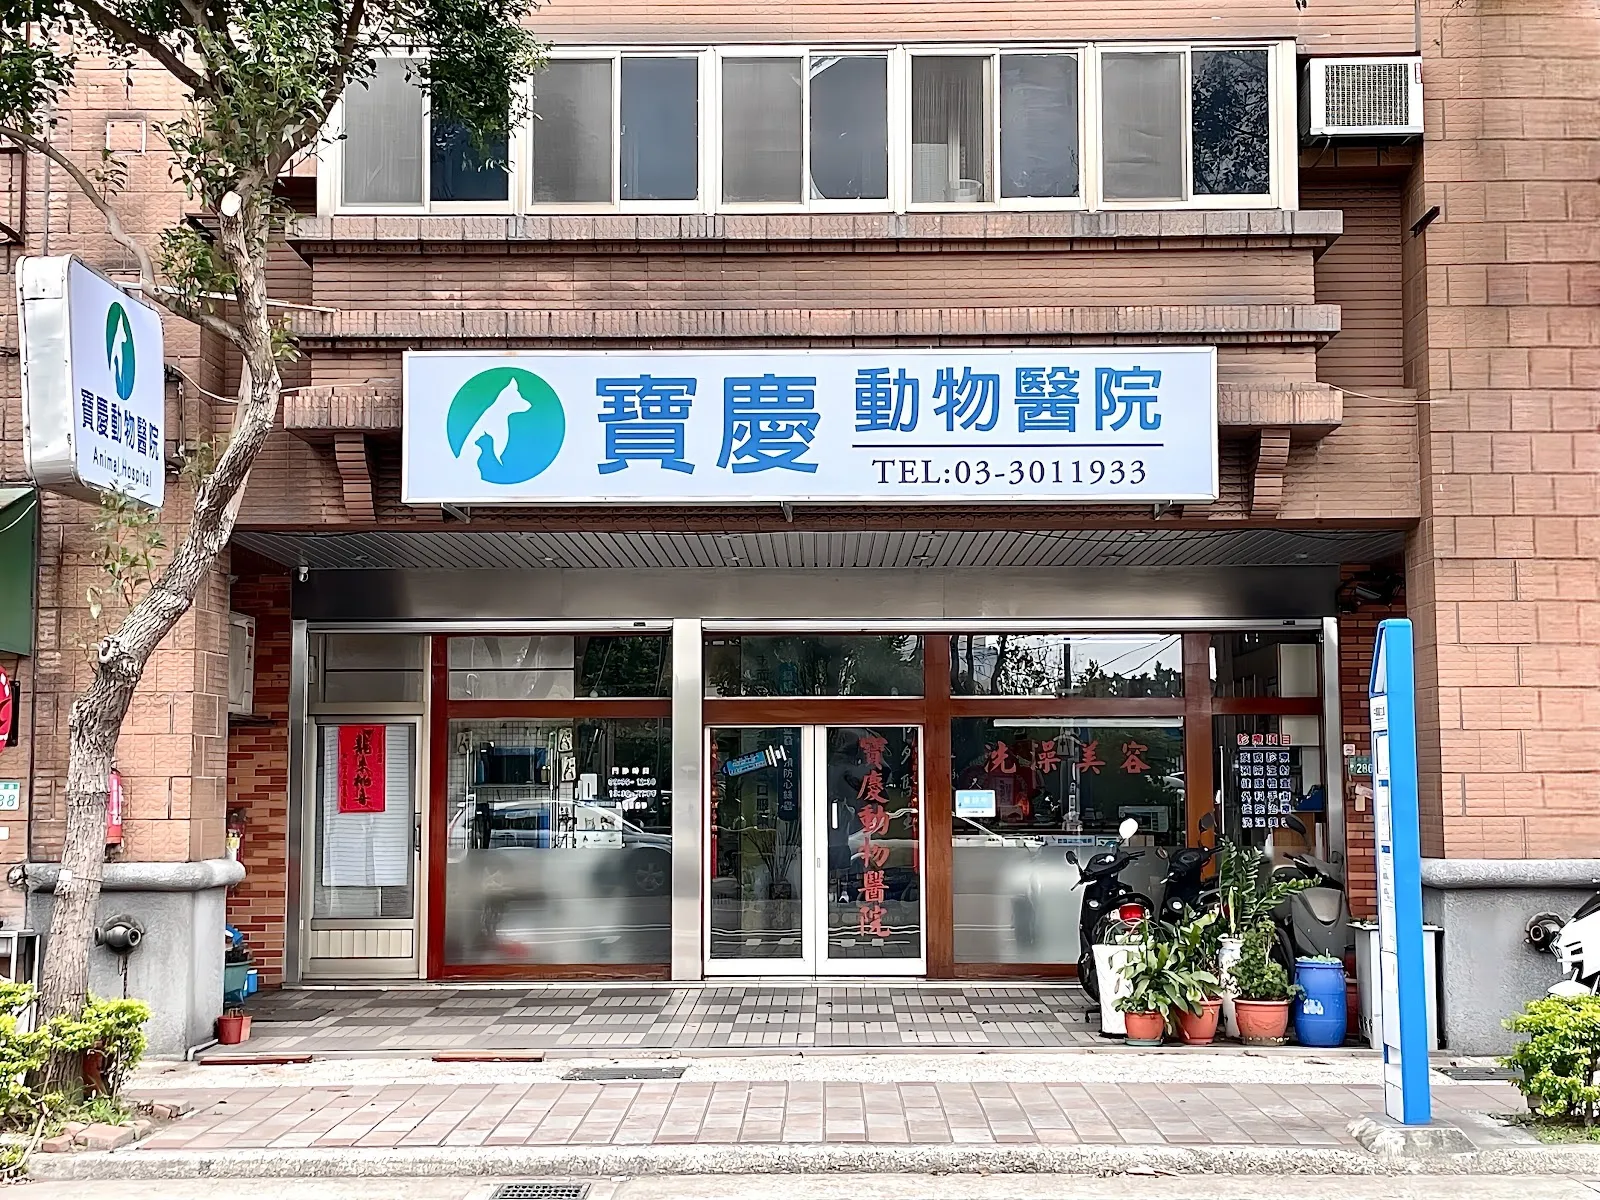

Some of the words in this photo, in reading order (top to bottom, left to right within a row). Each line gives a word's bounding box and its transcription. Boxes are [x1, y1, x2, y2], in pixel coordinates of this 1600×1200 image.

[81, 387, 160, 461] 寶慶動物醫院
[595, 373, 821, 475] 寶慶
[855, 365, 1163, 434] 動物醫院
[93, 446, 120, 476] Animal
[122, 457, 152, 488] Hospital
[871, 459, 1146, 485] TEL:03-3011933
[984, 740, 1152, 775] 洗澡美容
[857, 735, 891, 938] 寶慶動物醫院
